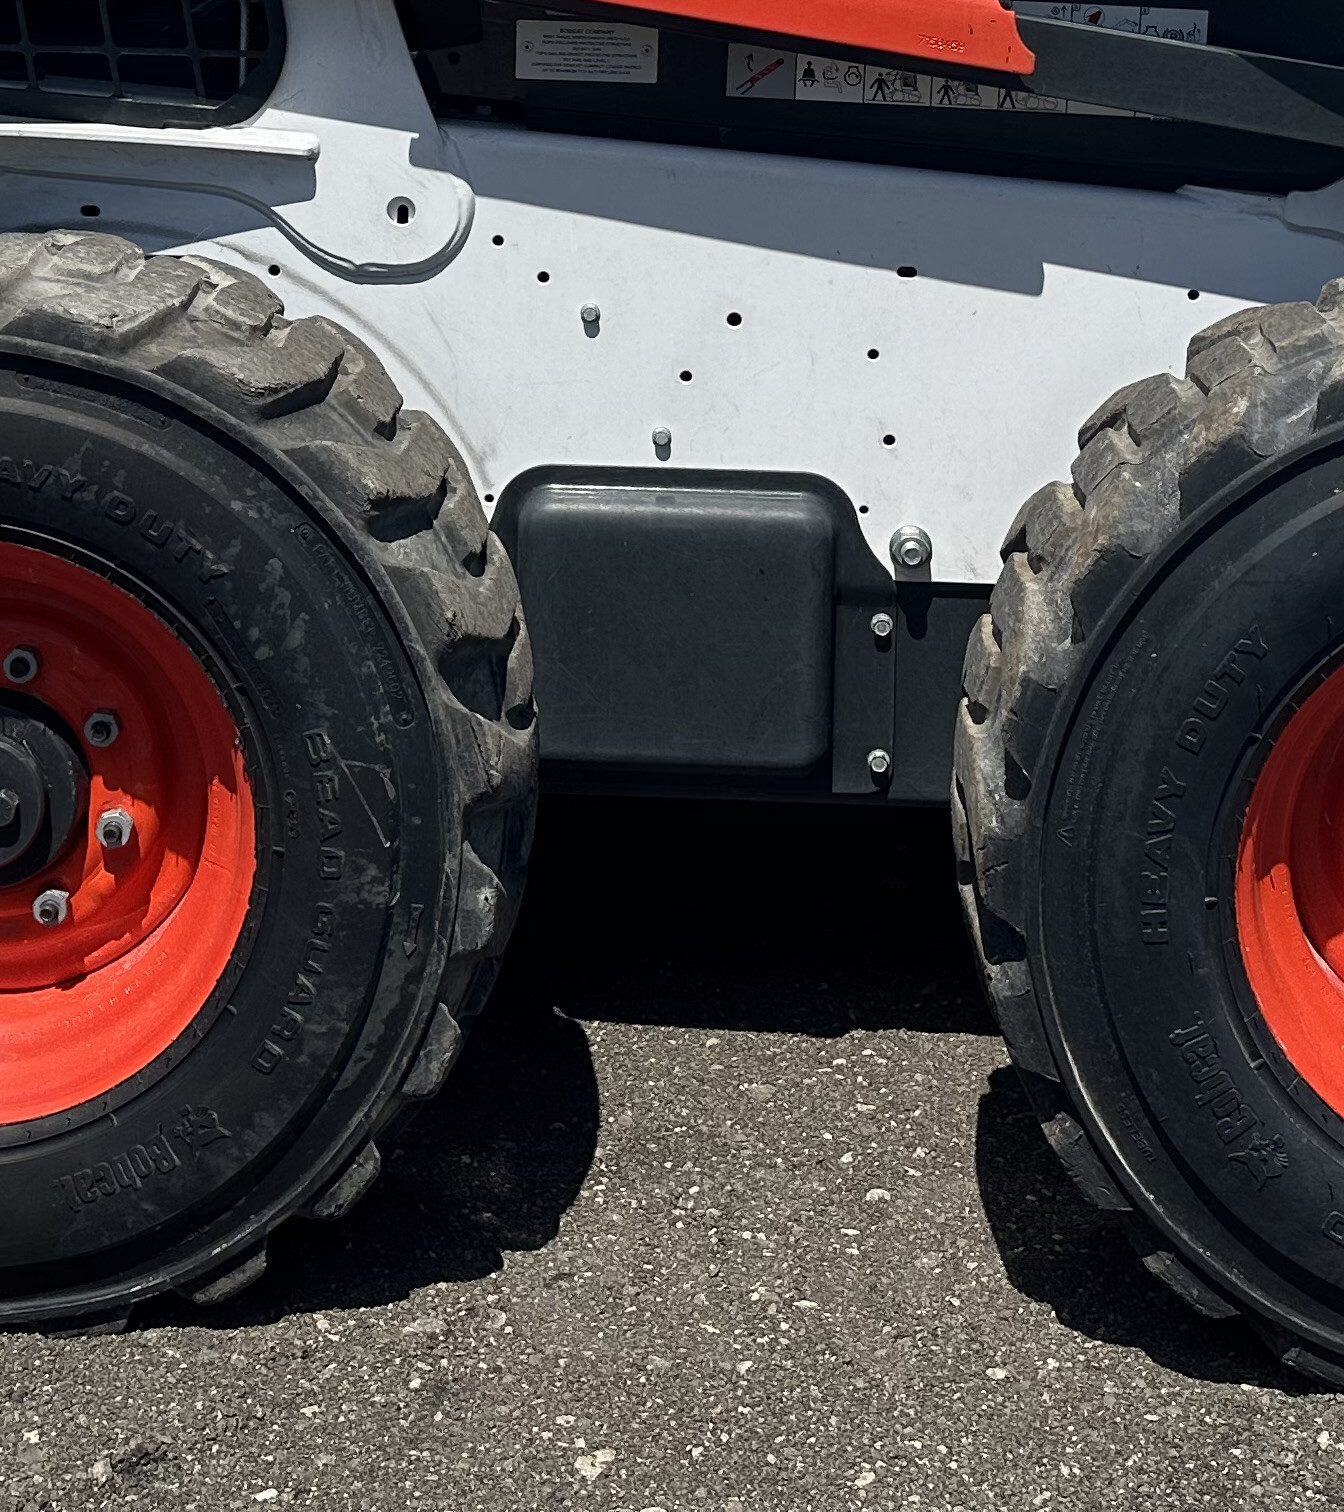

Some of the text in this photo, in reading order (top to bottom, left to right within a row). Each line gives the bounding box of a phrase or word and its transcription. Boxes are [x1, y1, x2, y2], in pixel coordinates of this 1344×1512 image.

[99, 489, 230, 584] DUTY
[301, 727, 347, 882] BEAD
[1140, 624, 1270, 947] HEAVY DUTY
[251, 902, 337, 1075] GUARD
[1168, 1010, 1257, 1144] Bobcat
